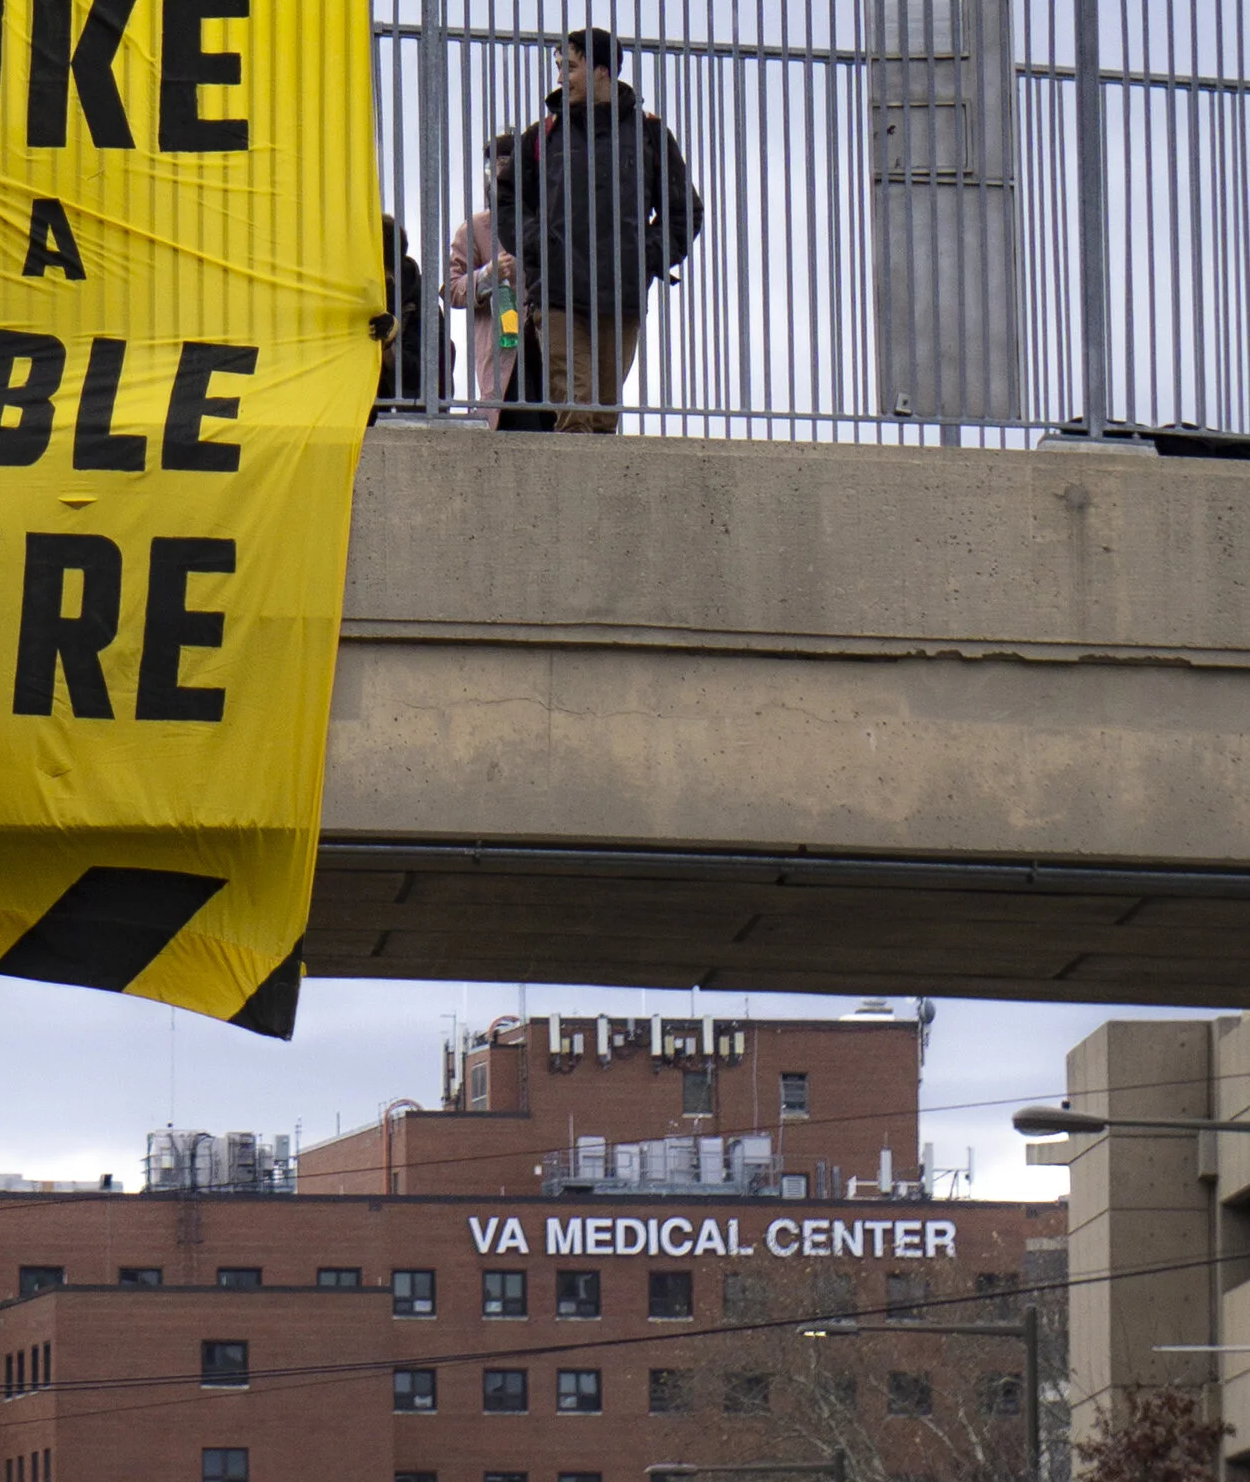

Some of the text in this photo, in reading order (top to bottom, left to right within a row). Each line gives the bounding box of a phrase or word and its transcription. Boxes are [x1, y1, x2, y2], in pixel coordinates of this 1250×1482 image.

[23, 198, 87, 281] A
[469, 1216, 957, 1258] VA MEDICAL CENTER
